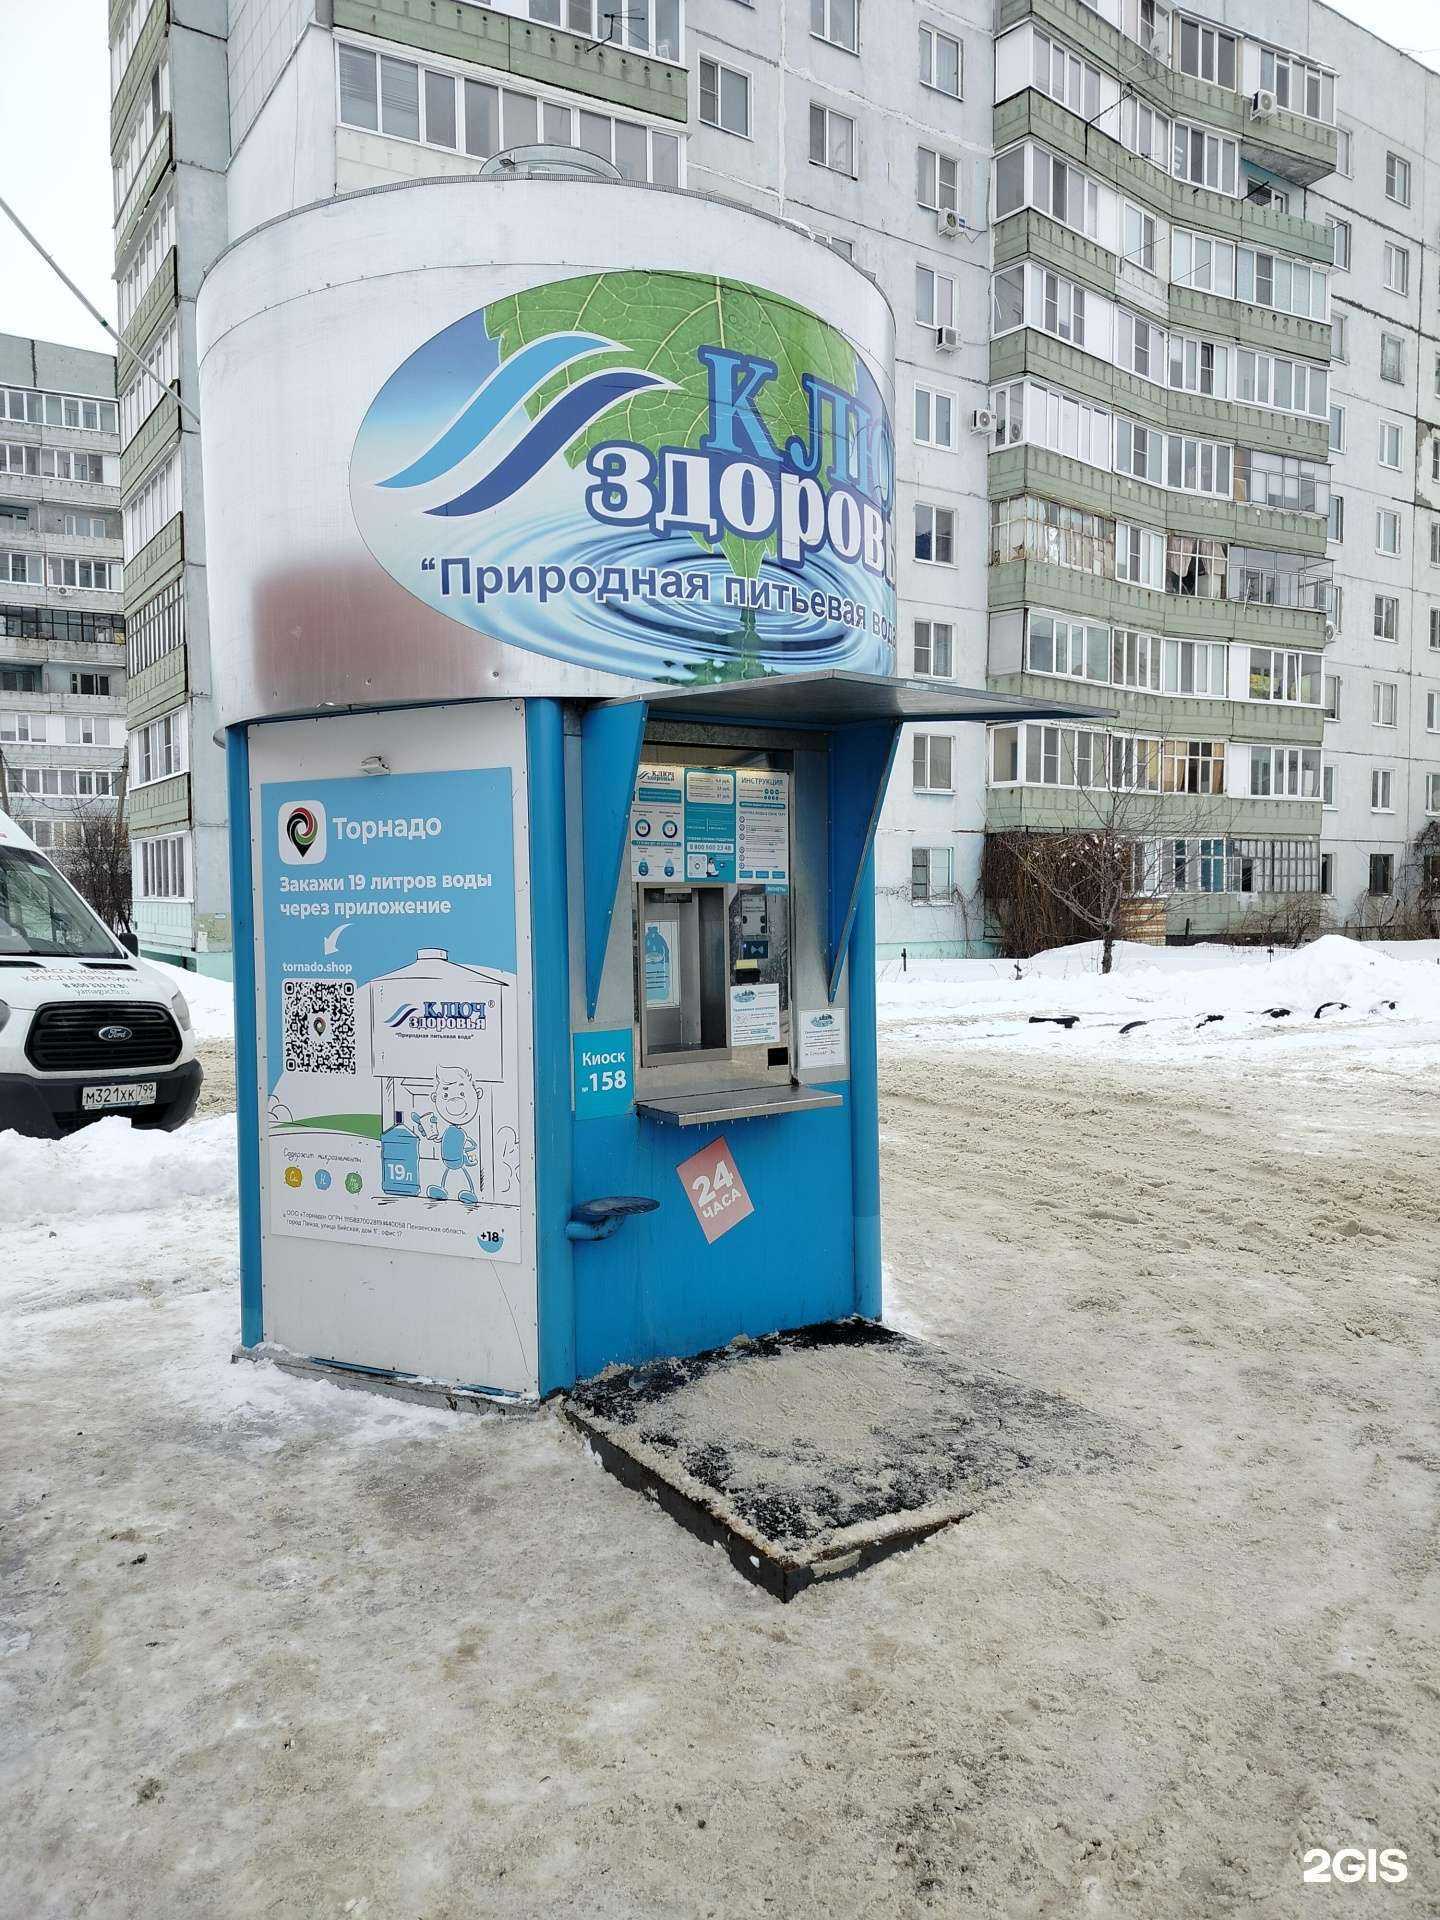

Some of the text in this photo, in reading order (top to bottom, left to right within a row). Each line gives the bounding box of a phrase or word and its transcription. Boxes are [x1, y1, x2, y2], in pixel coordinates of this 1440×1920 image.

[725, 574, 867, 630] питьевая
[332, 817, 442, 844] Торнадо
[279, 872, 492, 892] Закажи 19 литров воды
[280, 900, 451, 919] через приложение
[282, 962, 352, 974] tornado.shop
[423, 1001, 486, 1018] КЛЮЧ
[409, 1016, 486, 1032] здоровья
[582, 1052, 626, 1066] Киоск
[137, 1084, 154, 1095] 799
[589, 1070, 627, 1091] 158
[692, 1160, 734, 1208] 24
[702, 1188, 742, 1218] ЧАСА
[480, 1231, 500, 1243] +18
